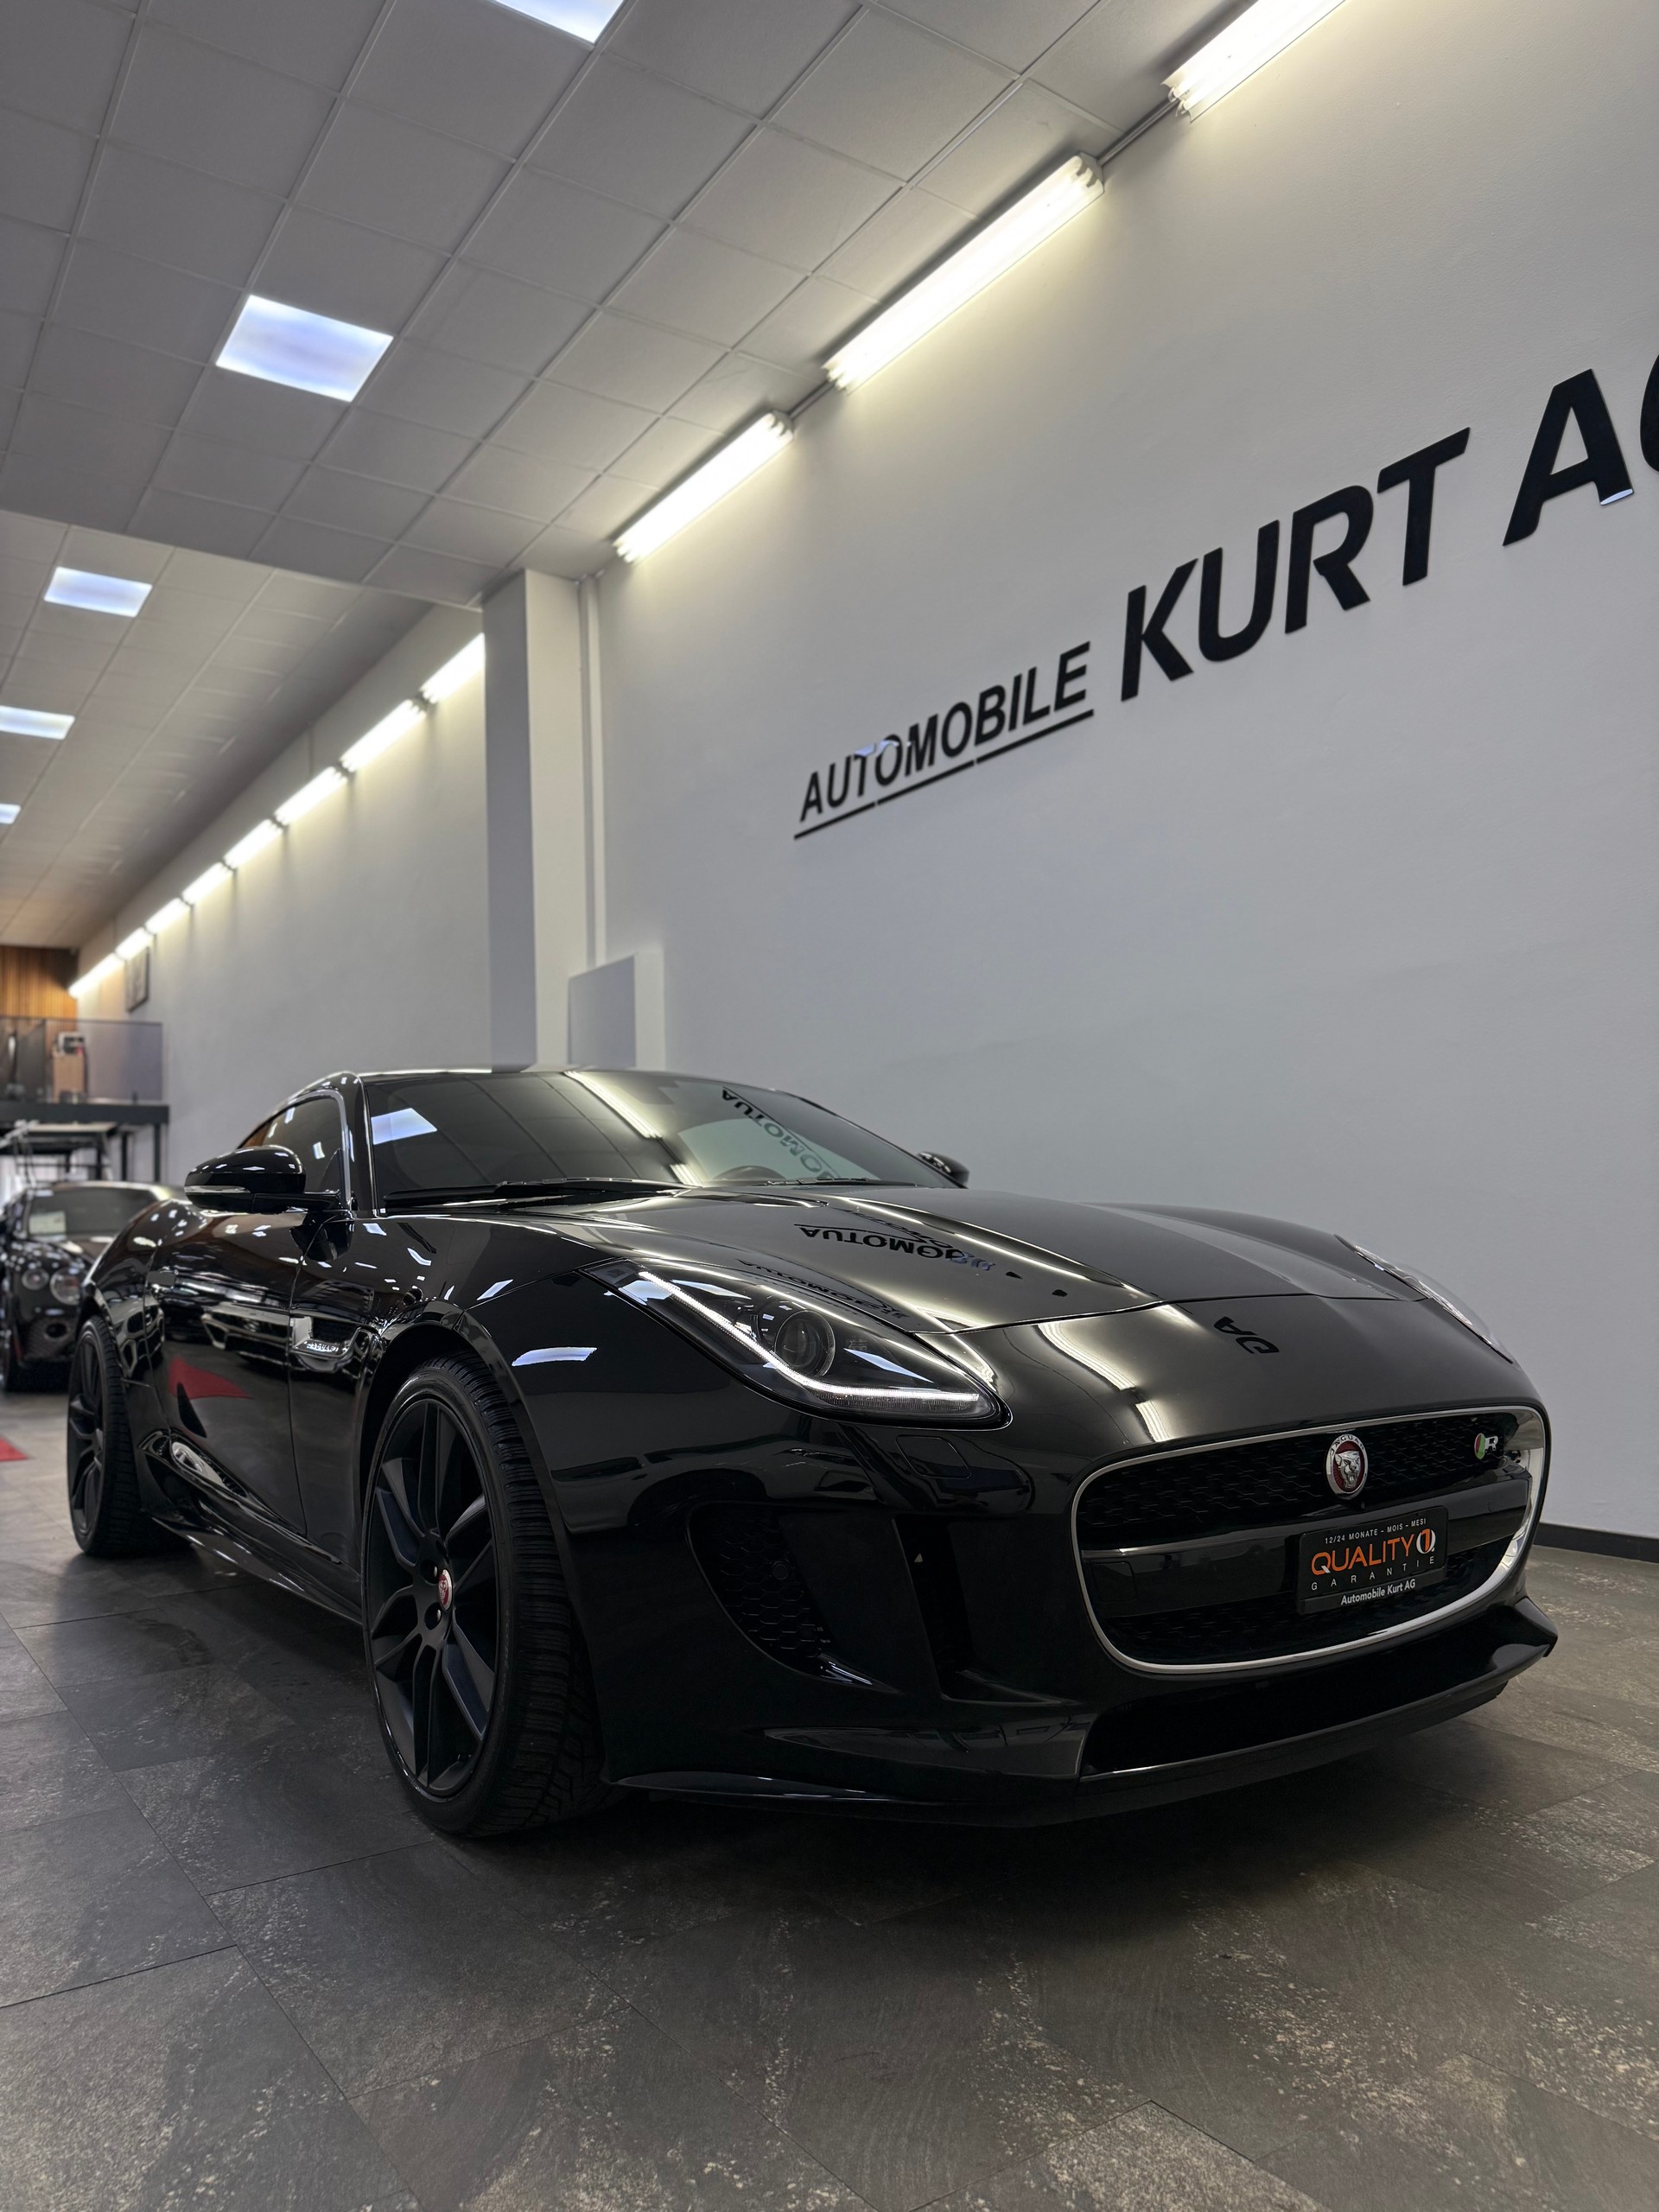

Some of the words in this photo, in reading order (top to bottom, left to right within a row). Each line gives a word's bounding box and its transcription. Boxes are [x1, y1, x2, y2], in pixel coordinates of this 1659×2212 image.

[799, 640, 1090, 823] AUTOMOBILE
[1120, 426, 1470, 702] KURT
[1331, 1435, 1364, 1456] JAGUAR
[1325, 1535, 1345, 1545] 12/24
[1349, 1529, 1379, 1541] MONATE
[1387, 1522, 1403, 1533] MOIS
[1411, 1517, 1427, 1528] MESI
[1311, 1534, 1414, 1576] QUALITY
[1311, 1555, 1434, 1591] GARANTIE
[1340, 1586, 1386, 1605] Automobile
[1387, 1582, 1403, 1595] Kurt
[1404, 1578, 1416, 1591] AG
